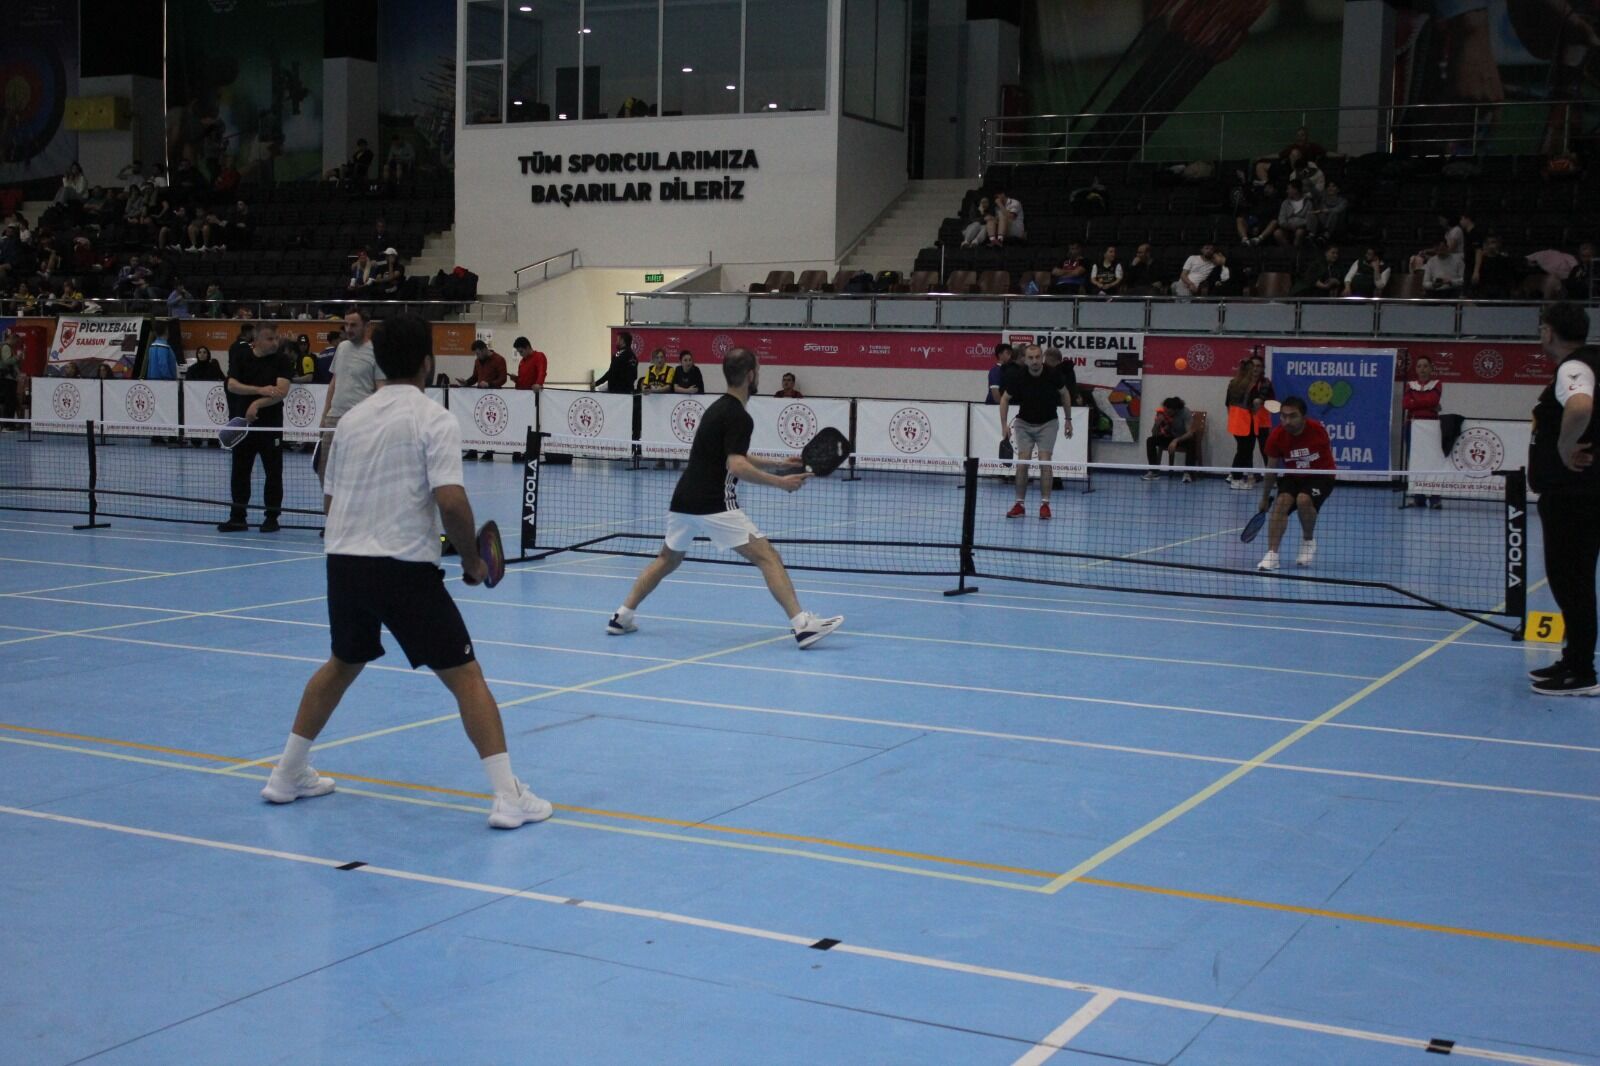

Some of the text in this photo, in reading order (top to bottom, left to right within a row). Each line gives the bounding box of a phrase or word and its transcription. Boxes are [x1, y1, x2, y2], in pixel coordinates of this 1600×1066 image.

[518, 149, 759, 174] TÜM SPORCULARIMIZA
[531, 176, 745, 207] BAŞARILAR DİLERİZ
[76, 338, 106, 346] SAMSUN
[1286, 359, 1378, 378] PICKLEBALL İLE
[525, 459, 538, 512] JOOLA
[1508, 527, 1522, 588] JOOLA
[1537, 616, 1552, 639] 5
